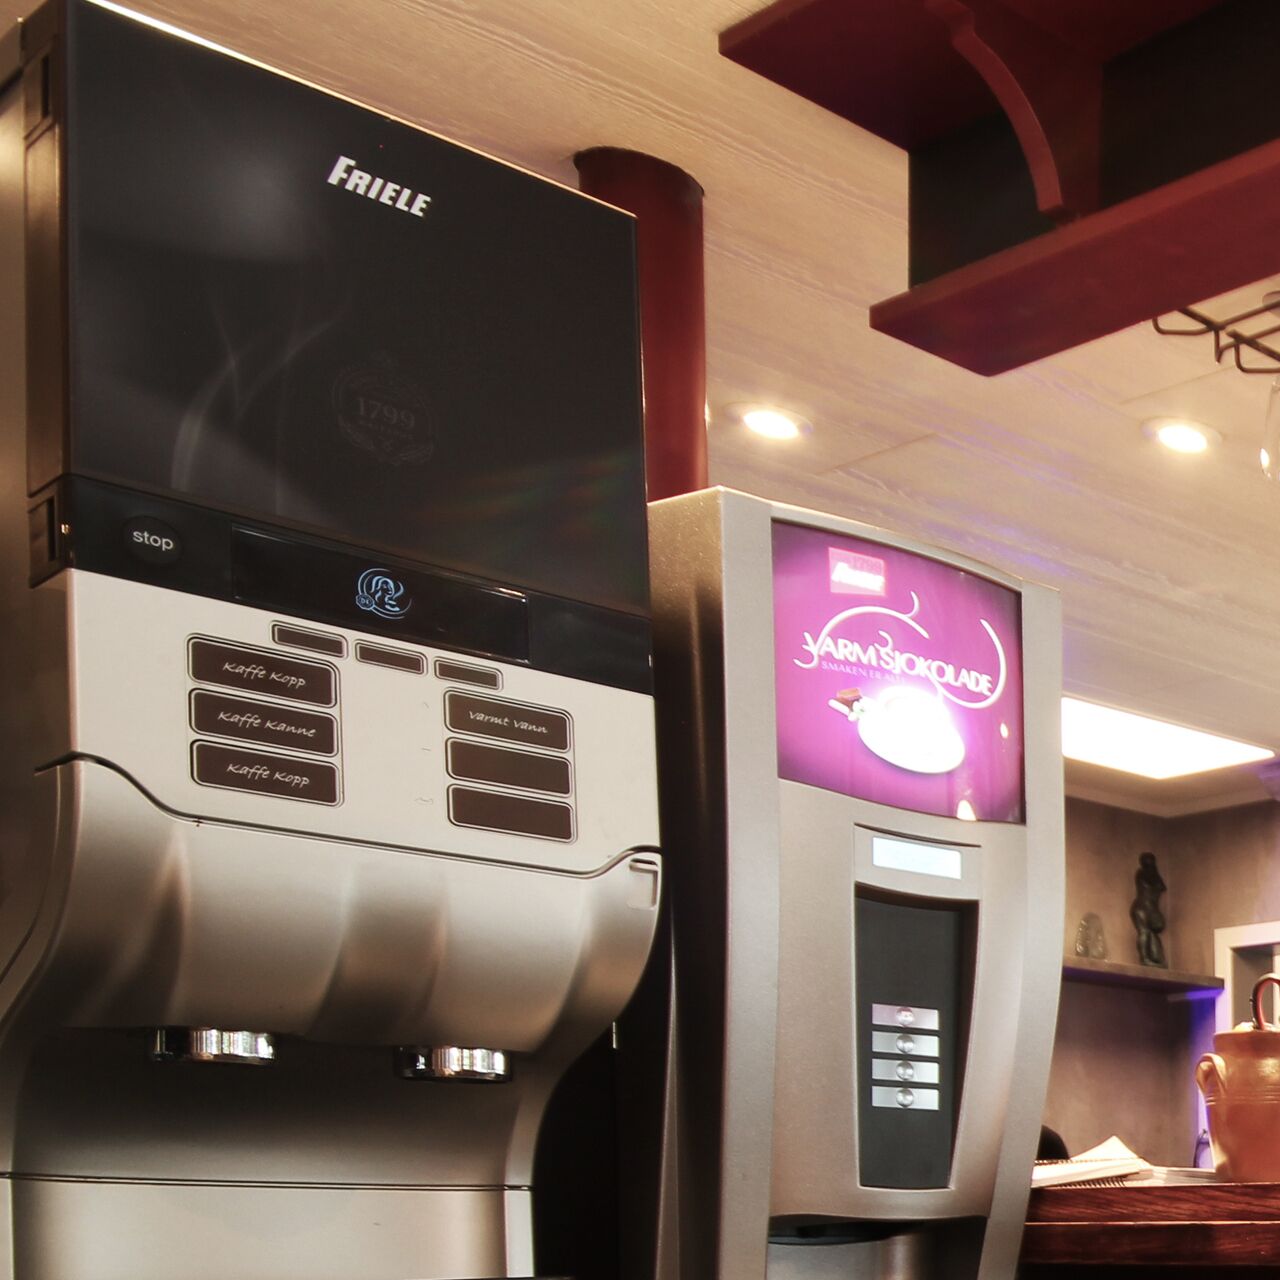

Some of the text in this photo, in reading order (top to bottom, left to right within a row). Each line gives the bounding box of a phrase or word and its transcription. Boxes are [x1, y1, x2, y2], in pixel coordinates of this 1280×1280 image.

[327, 155, 432, 217] FRIELE
[132, 531, 174, 551] stop
[222, 661, 306, 689] Kaffe Kopp
[821, 661, 867, 679] SMAKEN
[876, 640, 992, 698] SJOKOLADE
[217, 711, 317, 737] Kaffe Kanne
[226, 763, 310, 788] Kaffe Kopp
